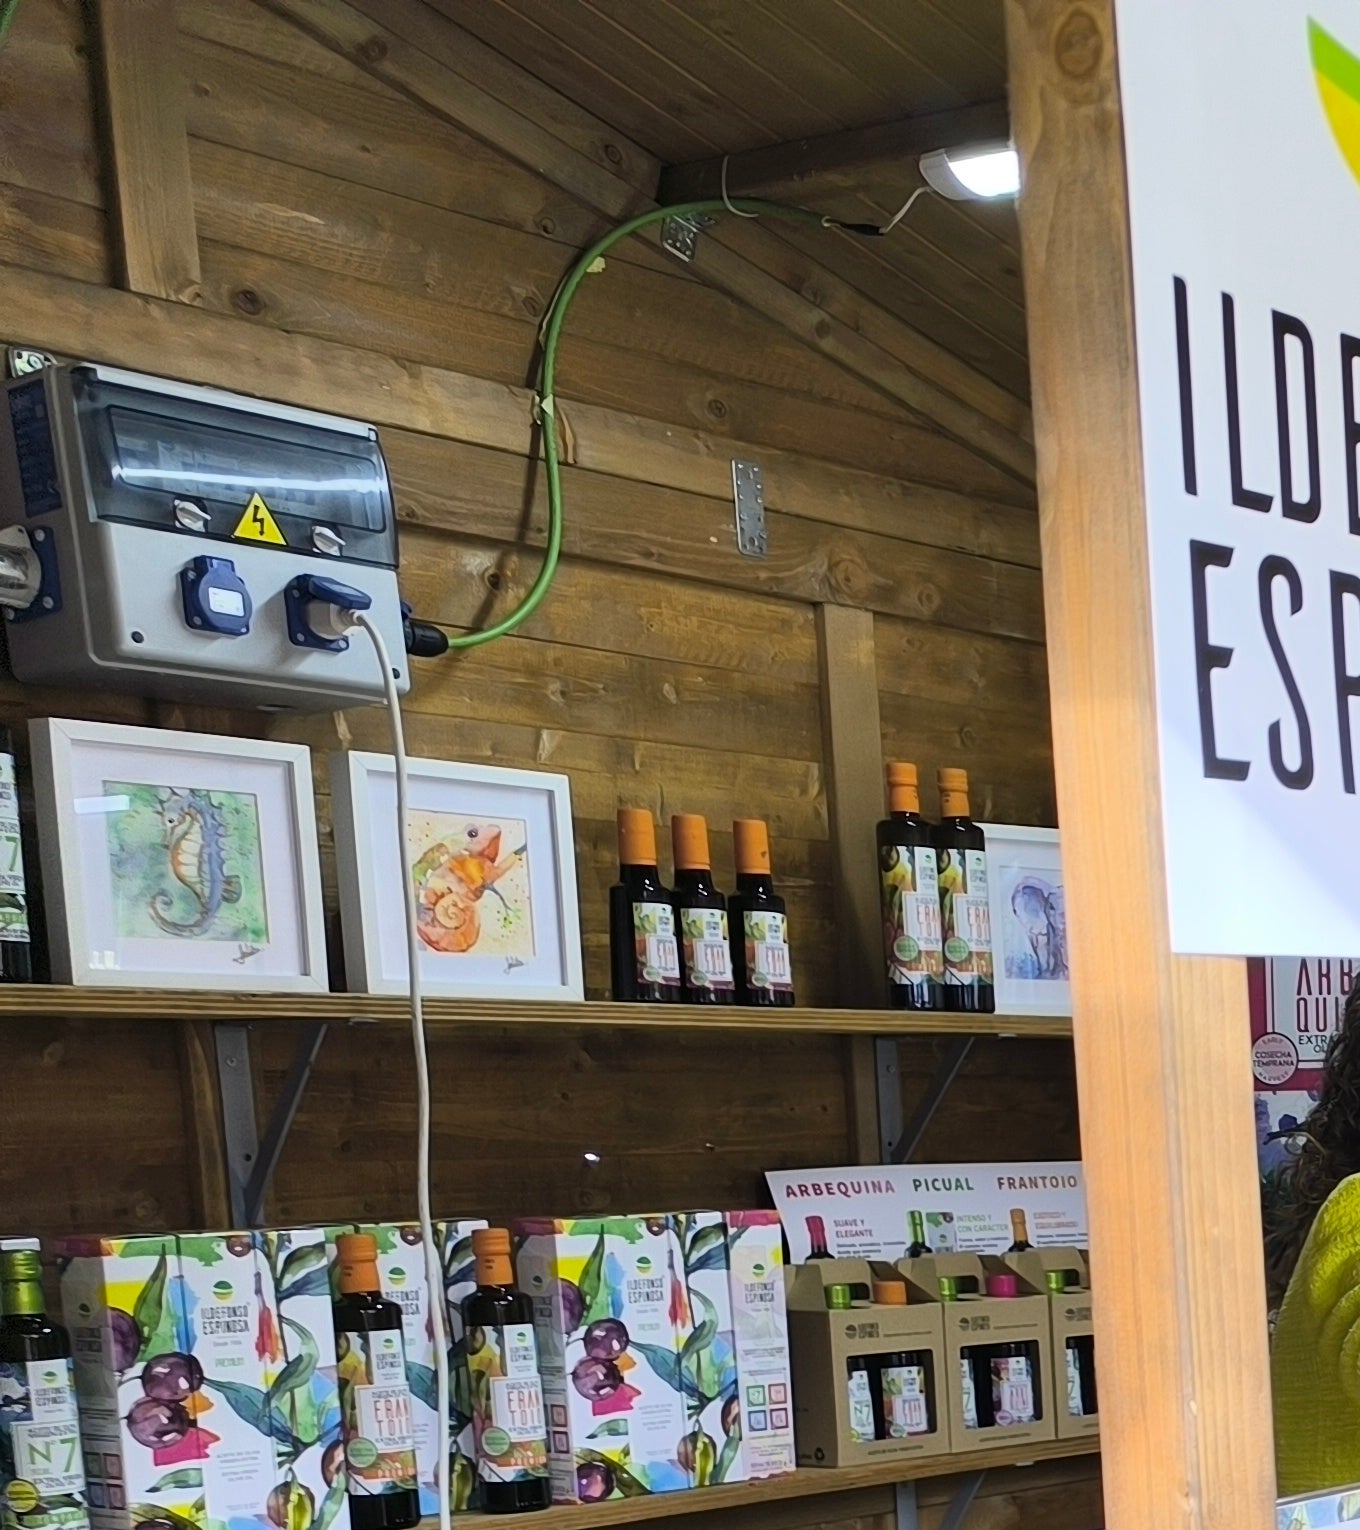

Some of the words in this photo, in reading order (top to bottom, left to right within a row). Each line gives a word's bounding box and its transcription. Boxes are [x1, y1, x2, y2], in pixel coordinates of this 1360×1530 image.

[1299, 1034, 1328, 1045] EXTR
[1254, 1051, 1292, 1059] COSECHA
[785, 1179, 895, 1199] ARBEQUINA
[912, 1177, 974, 1192] PICUAL
[996, 1175, 1078, 1191] FRANTOIO
[627, 1278, 664, 1290] ILDEFONSO
[628, 1291, 664, 1304] ESPINOSA
